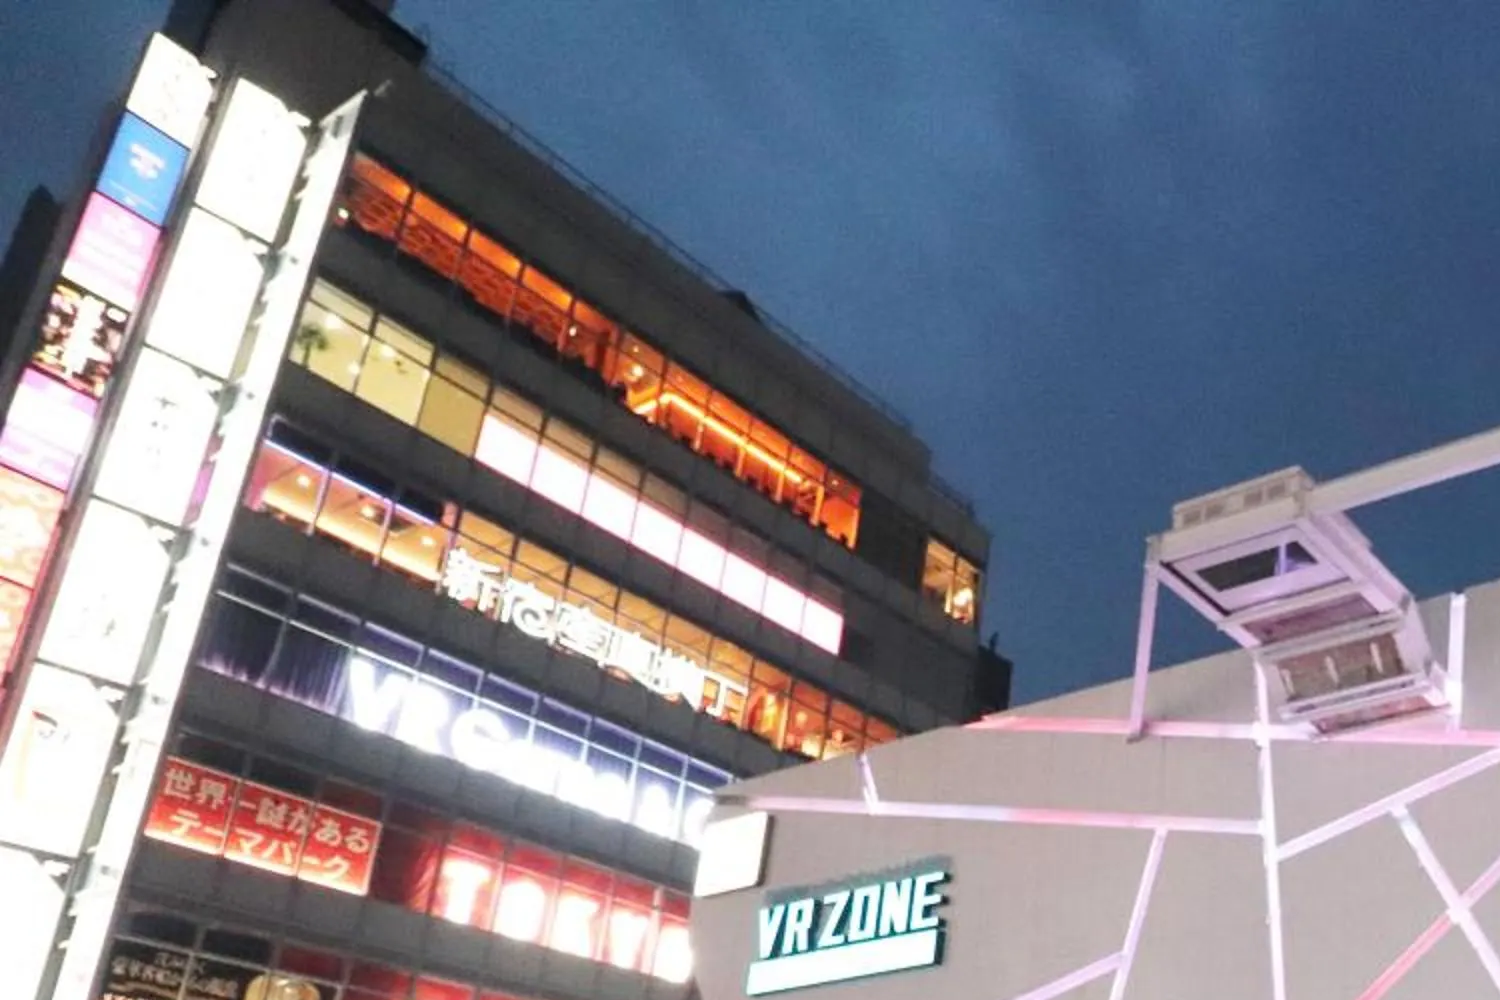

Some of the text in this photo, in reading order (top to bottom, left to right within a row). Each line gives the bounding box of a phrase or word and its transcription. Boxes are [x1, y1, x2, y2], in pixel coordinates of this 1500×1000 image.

[164, 766, 369, 854] 世界一謎がある
[169, 809, 351, 878] テーマパーク
[440, 858, 693, 984] TOKYO
[759, 871, 945, 959] VR ZONE
